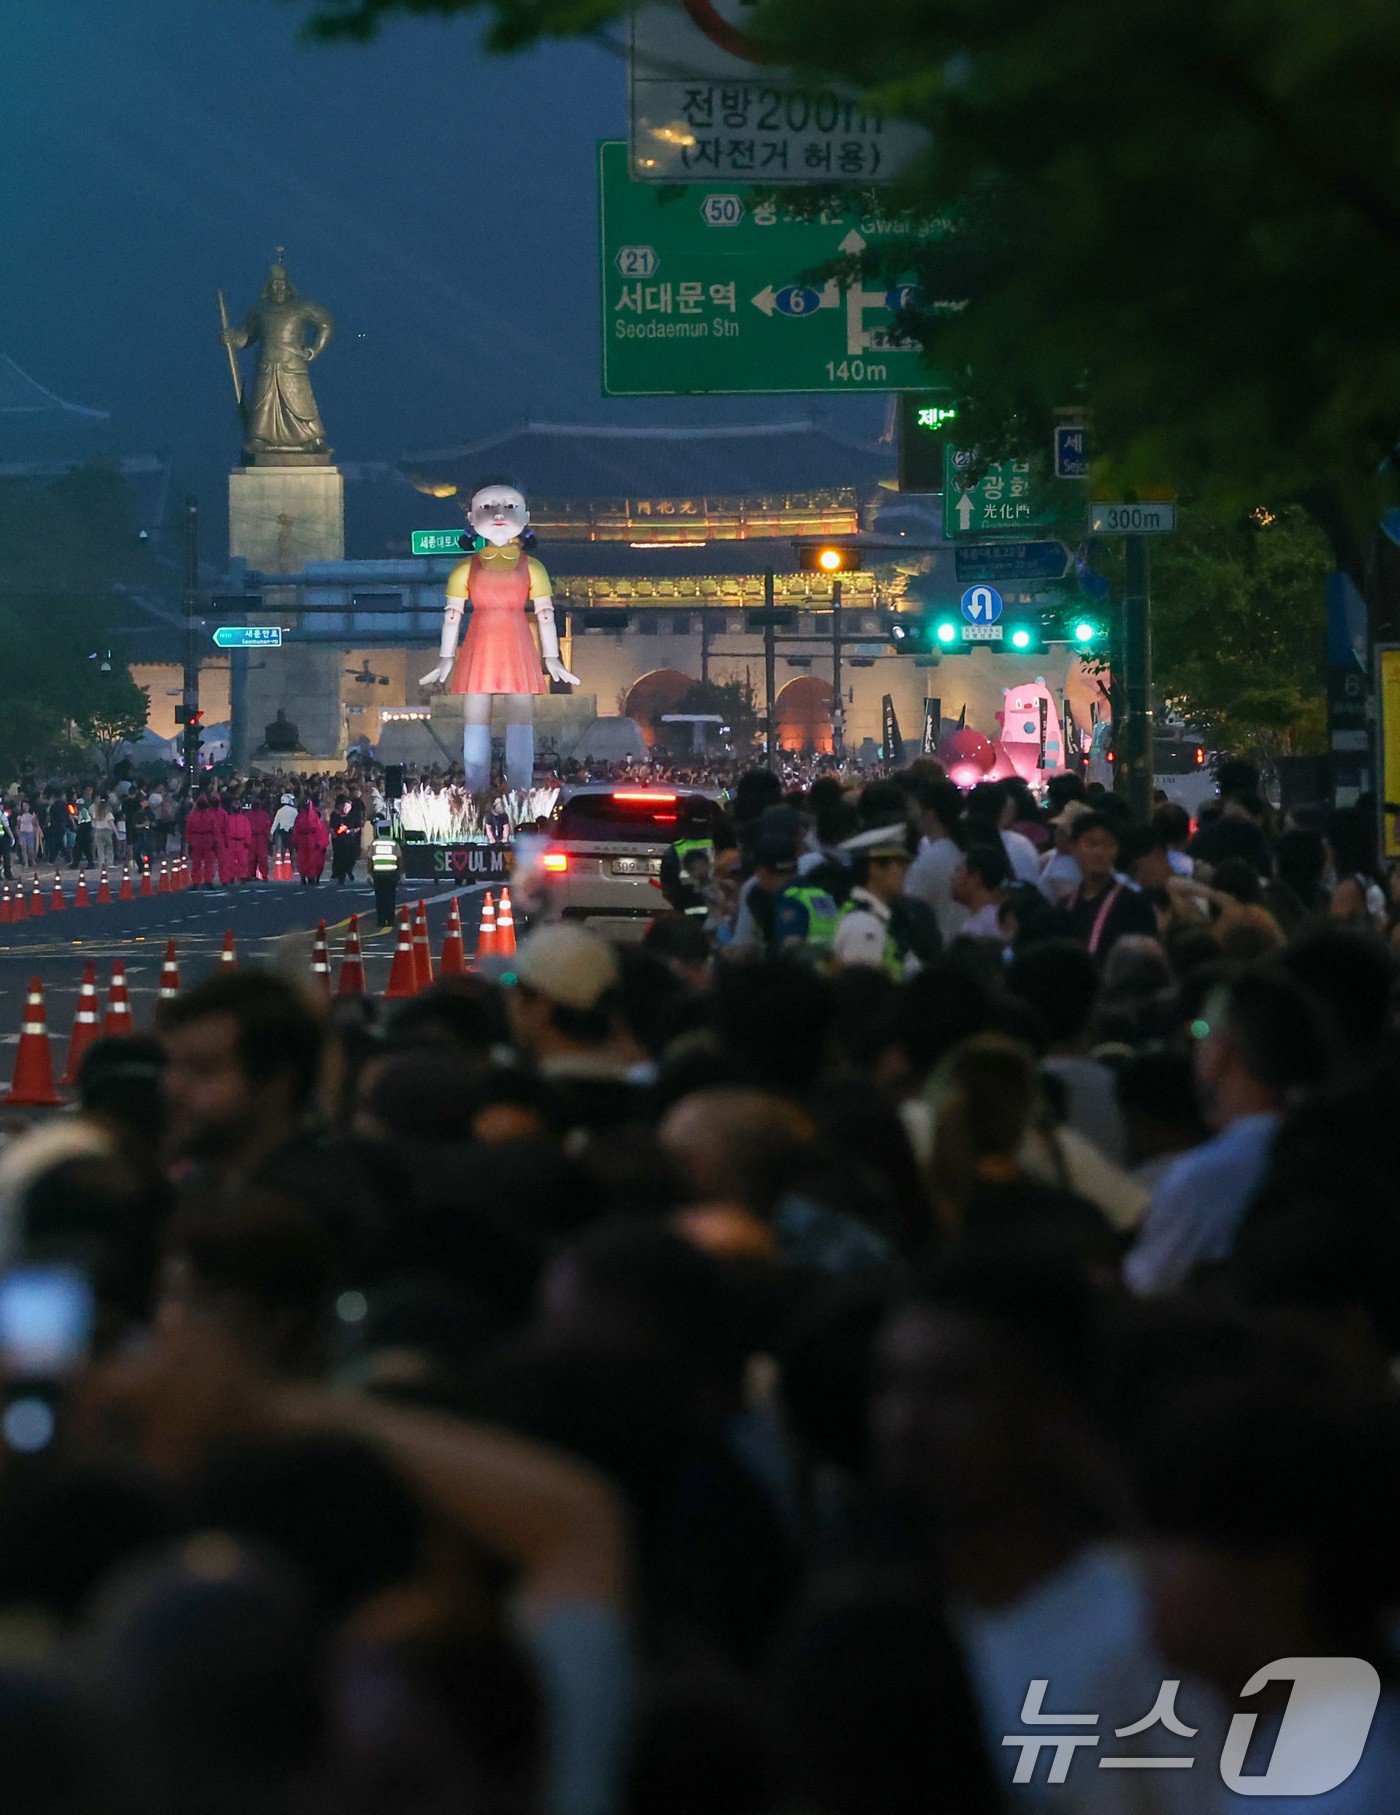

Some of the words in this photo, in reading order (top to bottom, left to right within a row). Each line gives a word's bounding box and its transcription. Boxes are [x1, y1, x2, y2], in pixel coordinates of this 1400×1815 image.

[803, 140, 881, 174] 허용)
[711, 201, 735, 221] 50
[626, 252, 651, 274] 21
[614, 281, 738, 314] 서대문역
[790, 289, 805, 313] 6
[615, 319, 708, 339] Seodaemun
[713, 317, 740, 338] Stn
[826, 360, 888, 382] 140m
[1107, 509, 1160, 529] 300m
